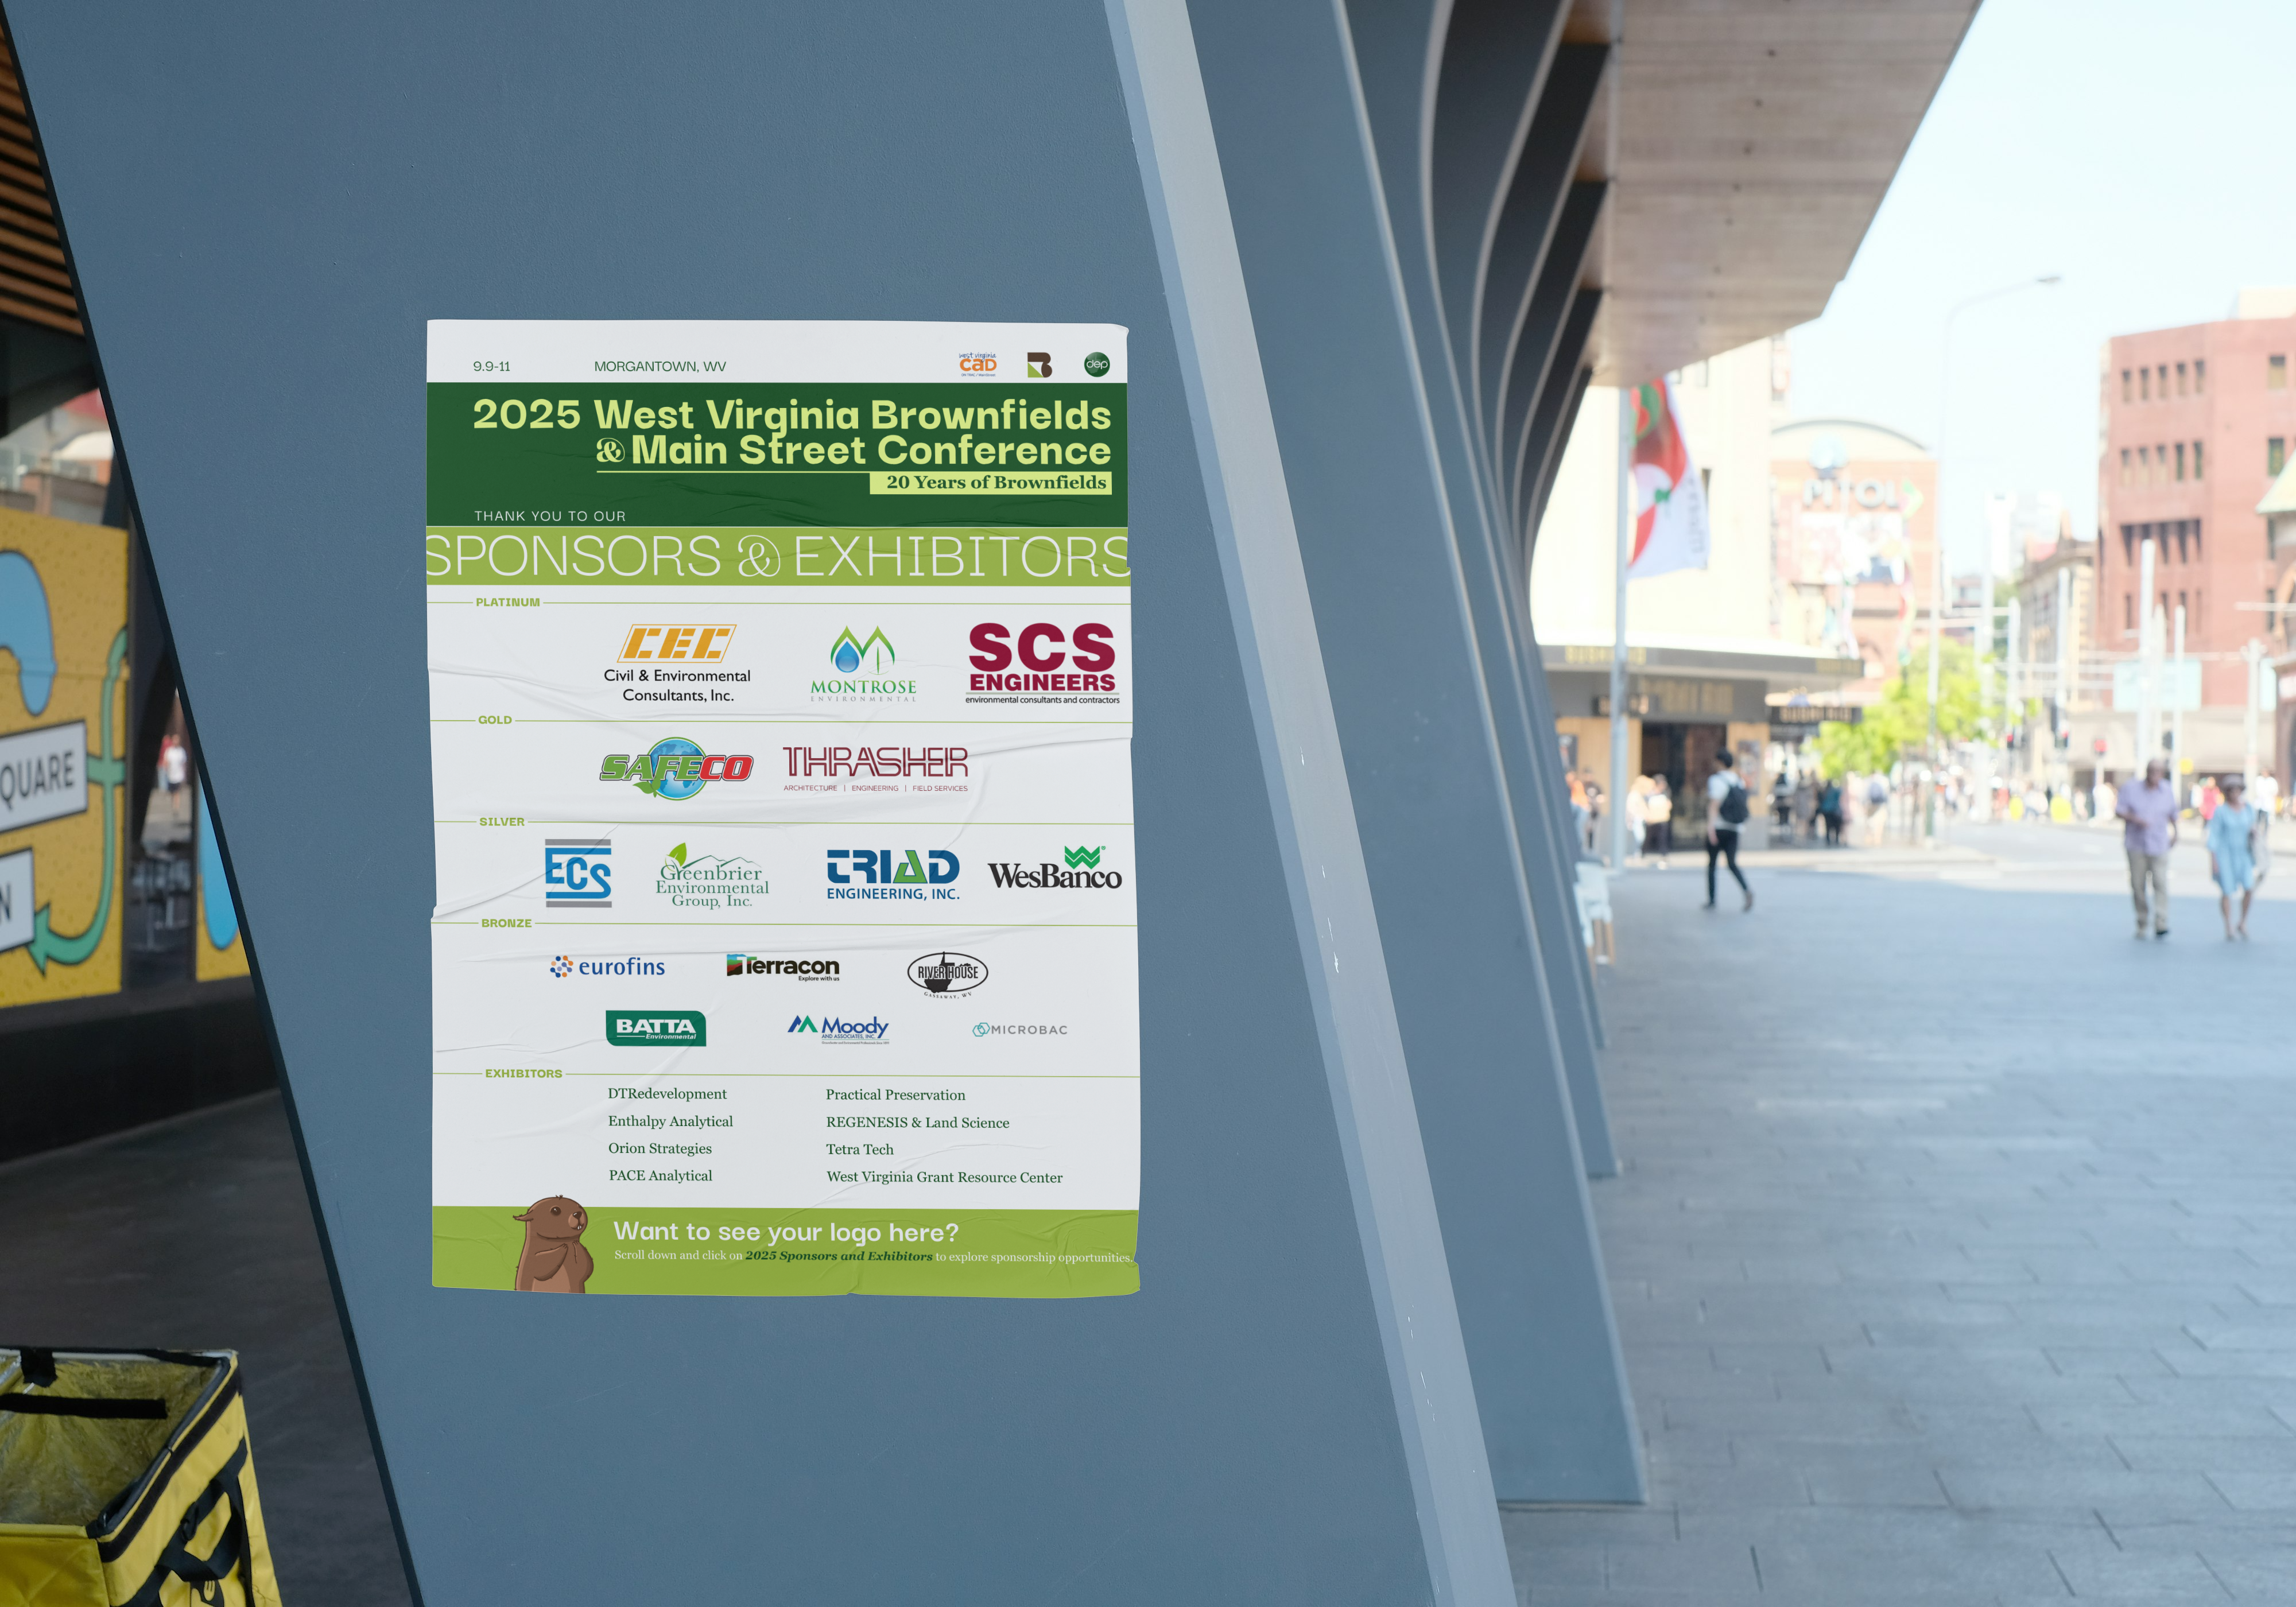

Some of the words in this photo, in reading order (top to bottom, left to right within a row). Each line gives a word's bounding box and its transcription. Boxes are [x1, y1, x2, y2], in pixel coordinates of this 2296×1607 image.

[975, 352, 996, 363] virginia
[1087, 359, 1108, 370] dep
[474, 361, 510, 372] 9.9-11
[595, 361, 700, 373] MORGANTOWN,
[704, 361, 726, 372] WV
[474, 399, 580, 429] 2025
[594, 399, 694, 429] West
[706, 398, 859, 438] Virginia
[872, 398, 1111, 430] Brownfields
[596, 437, 625, 463] &
[633, 434, 727, 464] Main
[740, 434, 866, 464] Street
[878, 434, 1111, 465] Conference
[887, 476, 910, 489] 20
[914, 476, 966, 490] Years
[971, 475, 991, 489] of
[994, 475, 1107, 490] Brownfields
[475, 511, 525, 522] THANK
[532, 511, 564, 522] YOU
[568, 511, 588, 522] TO
[594, 511, 626, 522] OUR
[426, 534, 721, 576] SPONSORS
[738, 534, 781, 577] &
[796, 535, 1131, 577] EXHIBITORS
[476, 597, 540, 607] PLATINUM
[623, 628, 731, 659] CEC
[969, 622, 1116, 672] SCS
[604, 669, 634, 682] Civil
[639, 670, 649, 682] &
[654, 669, 751, 682] Environmental
[810, 680, 917, 694] MONTROSE
[970, 674, 1116, 692] ENGINEERS
[623, 689, 707, 703] Consultants,
[711, 689, 734, 702] Inc.
[478, 715, 512, 725] GOLD
[599, 755, 754, 781] SAFECO
[783, 747, 968, 777] THRASHER
[0, 749, 73, 810] QUARE
[479, 817, 525, 827] SILVER
[545, 848, 611, 899] ECS
[661, 863, 762, 881] Greenbrier
[827, 849, 960, 884] TRIAD
[987, 863, 1123, 889] WesBanco
[656, 881, 769, 894] Environmental
[828, 888, 927, 901] ENGINEERING,
[932, 888, 960, 900] INC.
[672, 895, 720, 910] Group,
[727, 895, 752, 907] Inc.
[482, 919, 532, 929] BRONZE
[579, 957, 665, 975] eurofins
[736, 956, 839, 974] Terracon
[918, 966, 945, 979] RIVER
[948, 966, 979, 979] HOUSE
[616, 1019, 696, 1033] BATTA
[821, 1016, 889, 1038] Moody
[991, 1025, 1067, 1035] MICROBAC
[486, 1069, 563, 1078] EXHIBITORS
[608, 1088, 727, 1102] DTRedevelopment
[826, 1089, 881, 1101] Practical
[885, 1089, 966, 1101] Preservation
[608, 1115, 666, 1129] Enthalpy
[670, 1116, 733, 1129] Analytical
[827, 1116, 908, 1128] REGENESIS
[912, 1117, 922, 1128] &
[925, 1117, 958, 1128] Land
[961, 1117, 1010, 1129] Science
[608, 1143, 646, 1154] Orion
[649, 1143, 712, 1156] Strategies
[826, 1144, 860, 1155] Tetra
[863, 1144, 894, 1155] Tech
[609, 1170, 645, 1181] PACE
[649, 1169, 712, 1183] Analytical
[827, 1171, 859, 1182] West
[862, 1171, 913, 1185] Virginia
[917, 1171, 955, 1183] Grant
[958, 1171, 1017, 1183] Resource
[1020, 1172, 1063, 1183] Center
[614, 1221, 678, 1240] Want
[687, 1222, 711, 1240] to
[718, 1225, 761, 1241] see
[768, 1226, 822, 1246] your
[831, 1223, 881, 1247] logo
[890, 1223, 959, 1242] here?
[615, 1249, 645, 1260] Scroll
[647, 1249, 677, 1260] down
[680, 1249, 700, 1260] and
[703, 1249, 727, 1260] click
[746, 1251, 777, 1260] 2025
[779, 1251, 837, 1263] Sponsors
[841, 1251, 865, 1261] and
[868, 1251, 933, 1261] Exhibitors
[936, 1253, 947, 1261] to
[949, 1252, 988, 1264] explore
[991, 1253, 1056, 1264] sponsorship
[1058, 1253, 1133, 1264] opportunities.
